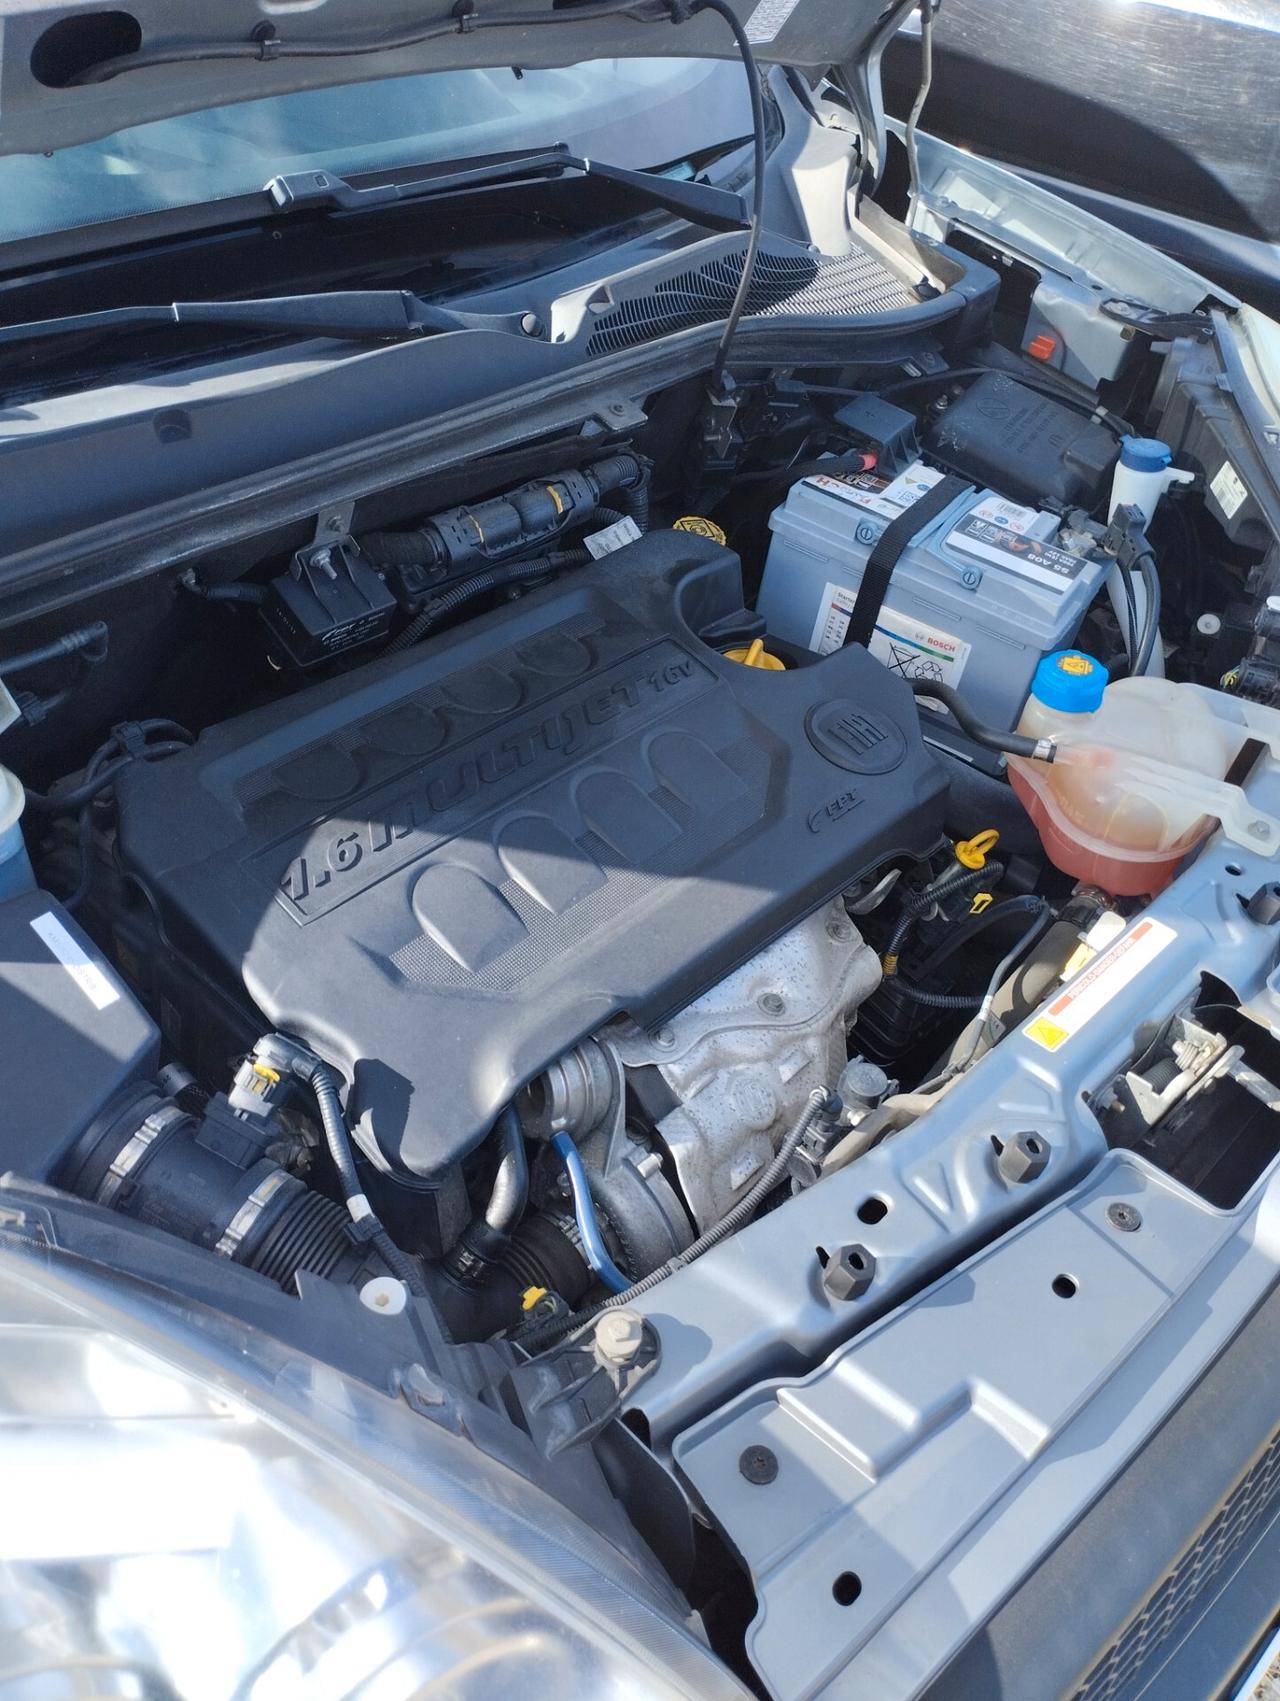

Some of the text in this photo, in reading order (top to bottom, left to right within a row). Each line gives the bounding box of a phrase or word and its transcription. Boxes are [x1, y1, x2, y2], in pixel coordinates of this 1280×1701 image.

[927, 636, 956, 652] BOSCH
[826, 713, 889, 756] FIAT
[280, 829, 365, 902] 1.6
